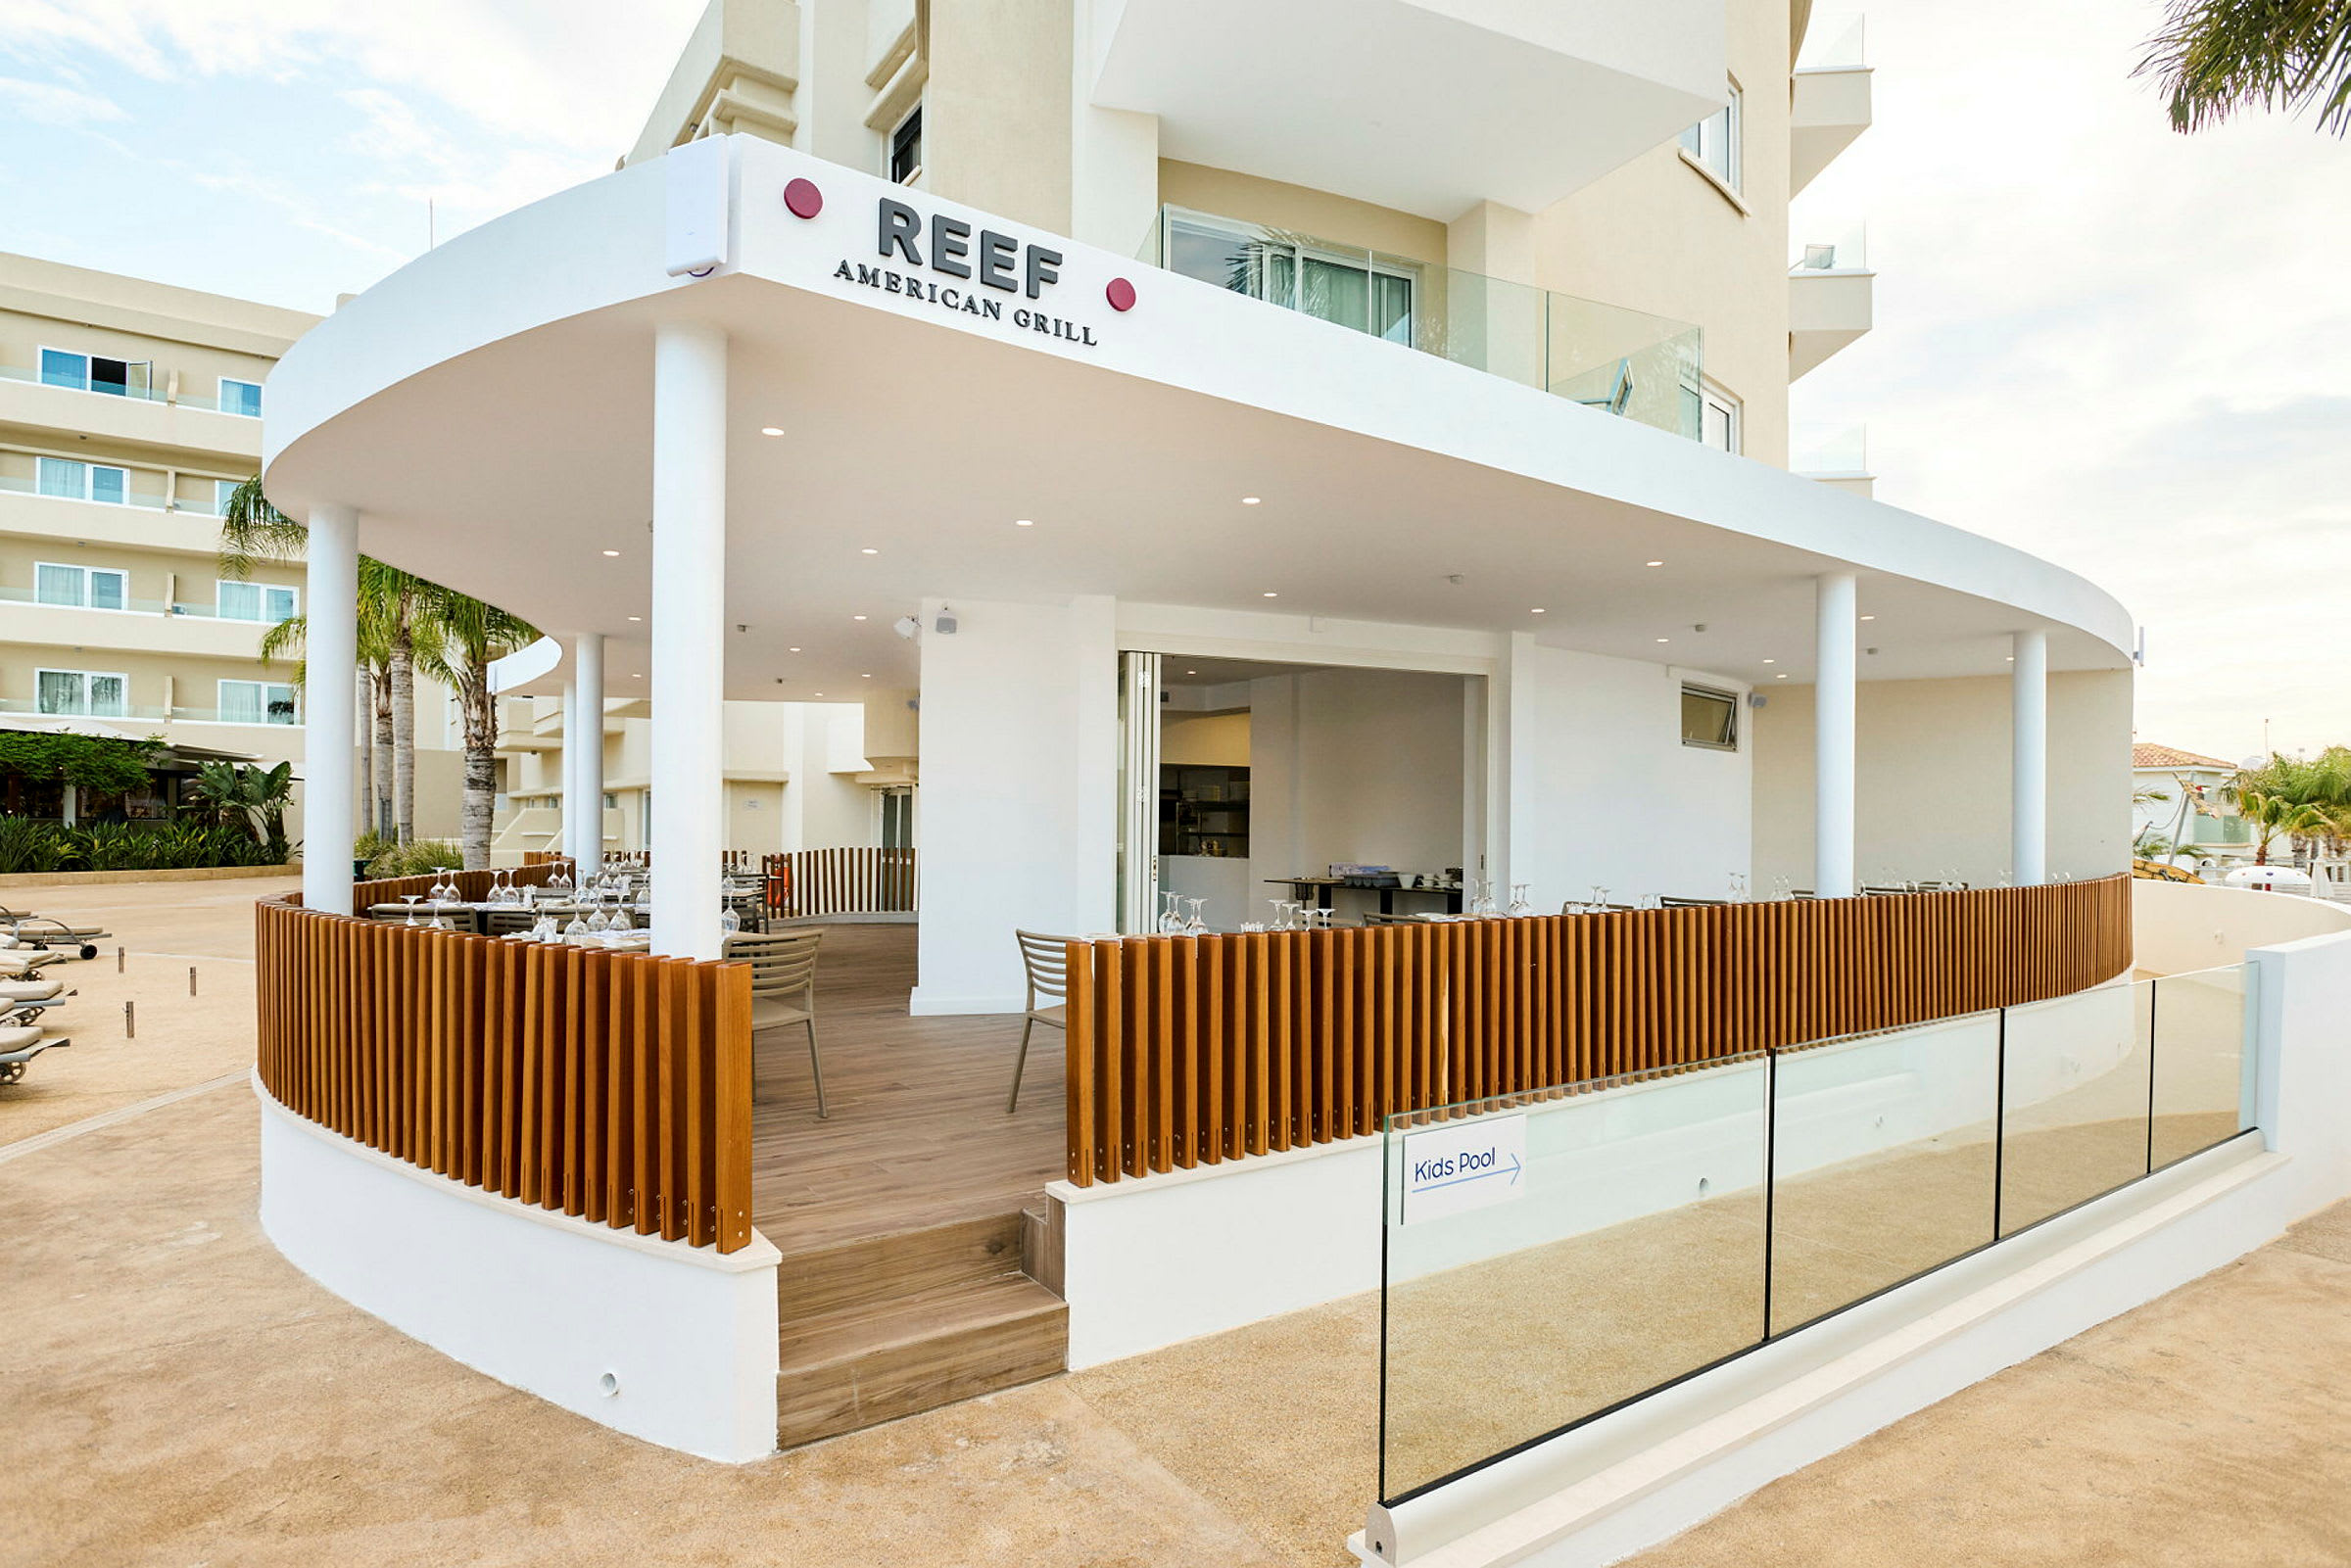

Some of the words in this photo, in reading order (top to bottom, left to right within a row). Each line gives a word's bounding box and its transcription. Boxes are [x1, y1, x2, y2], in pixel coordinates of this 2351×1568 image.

[879, 197, 1063, 300] REEF
[834, 259, 1002, 320] AMERICAN
[1014, 309, 1098, 347] GRILL
[1415, 1158, 1454, 1182] Kids
[1460, 1147, 1496, 1172] Pool
